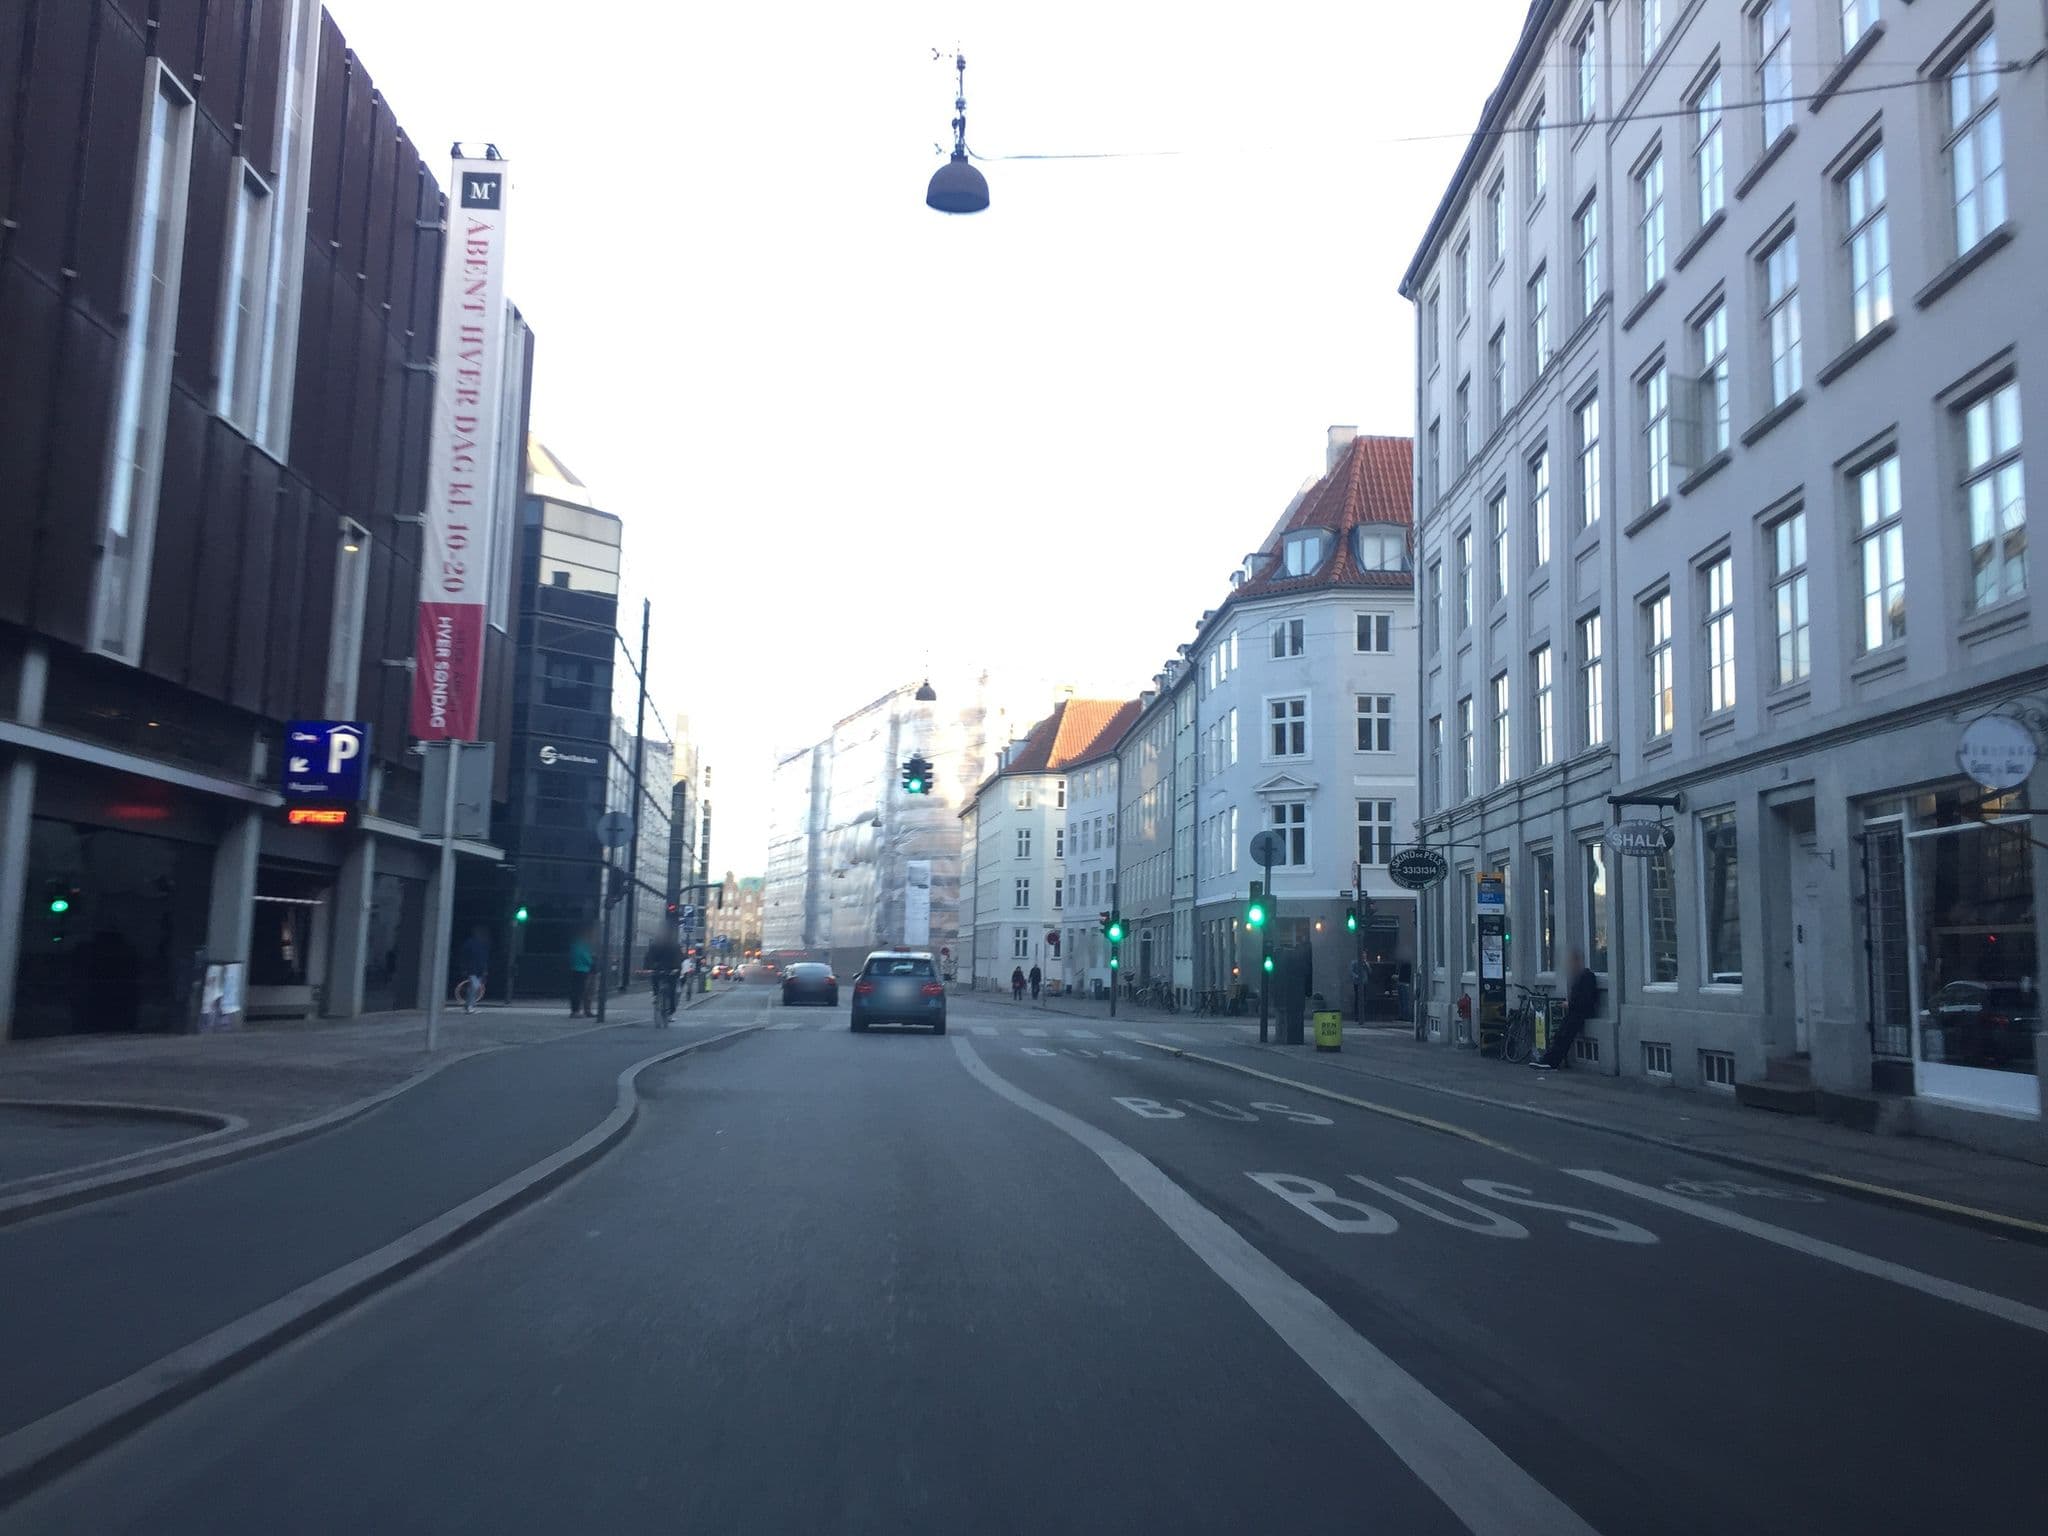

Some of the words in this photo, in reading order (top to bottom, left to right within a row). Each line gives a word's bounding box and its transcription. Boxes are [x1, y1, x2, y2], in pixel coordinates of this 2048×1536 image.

[464, 216, 494, 318] ÅBENT
[456, 325, 484, 406] HVER
[452, 416, 479, 473] DAG
[443, 524, 470, 593] 10-20
[435, 616, 454, 658] HVER
[430, 661, 450, 728] SØNDAG
[327, 733, 360, 774] P
[1402, 866, 1438, 874] 33131314
[1423, 851, 1444, 866] PELS
[1111, 1096, 1335, 1125] BUS
[1243, 1171, 1661, 1245] BUS
